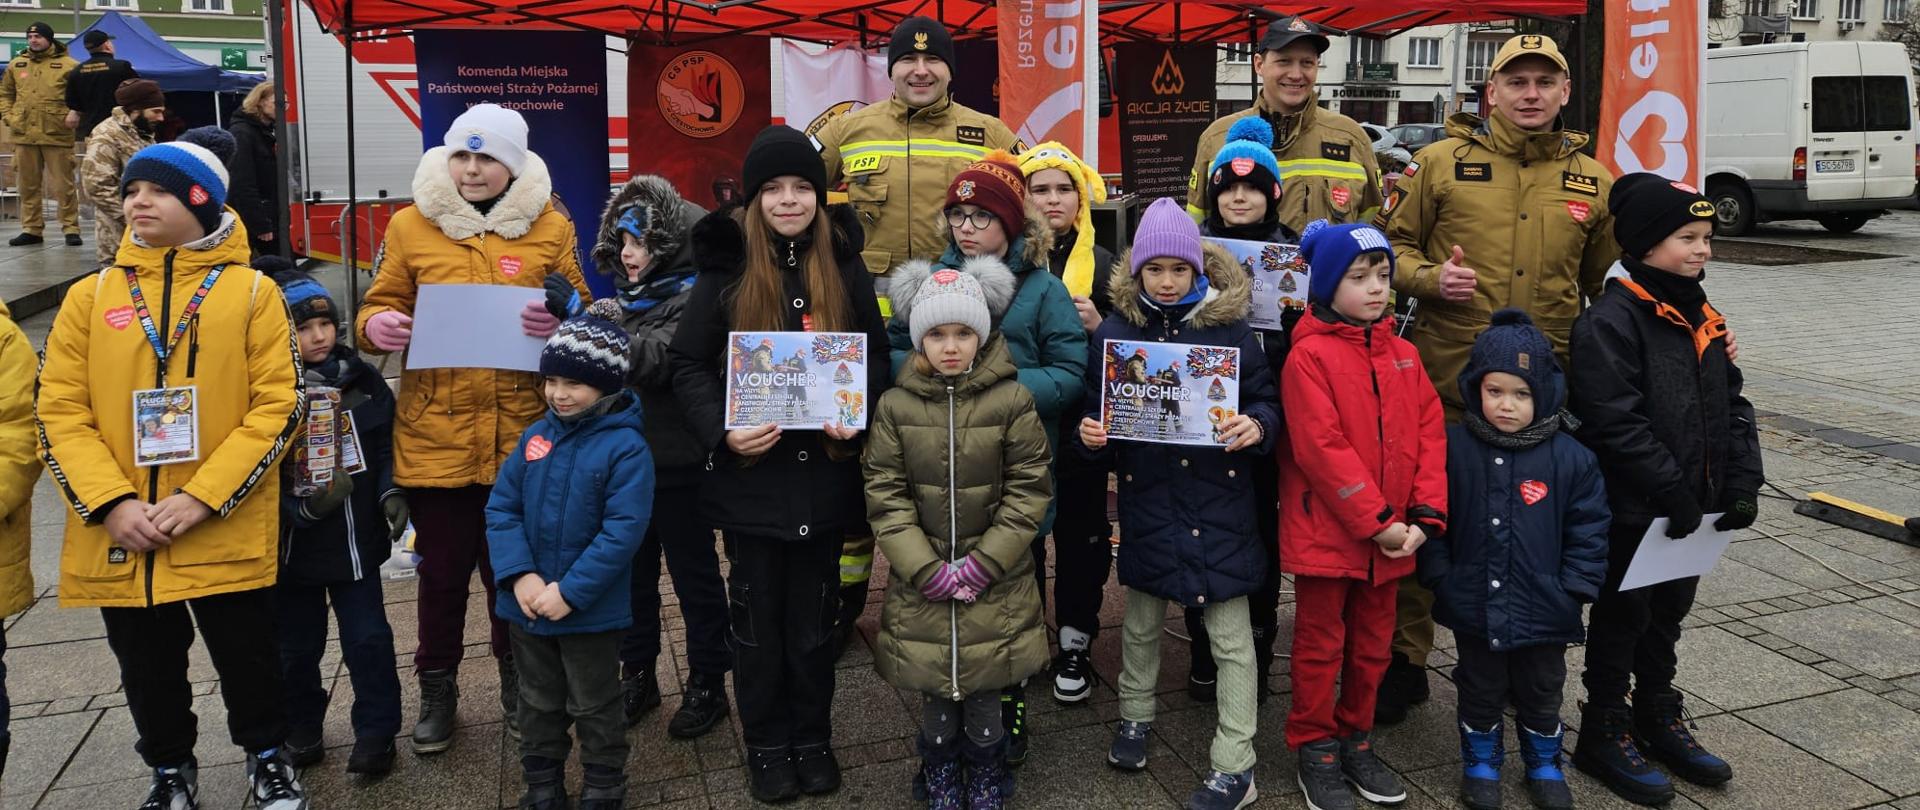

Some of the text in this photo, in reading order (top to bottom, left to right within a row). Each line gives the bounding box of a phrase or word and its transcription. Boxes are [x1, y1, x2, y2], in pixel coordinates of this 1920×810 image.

[682, 56, 705, 68] PSP
[457, 66, 568, 78] Komenda Miejska
[428, 83, 599, 95] Państwowej Straży Pożarnej
[1332, 89, 1401, 98] BOULANGERIE
[1128, 99, 1210, 115] AKCJA ŻYCIE
[854, 157, 876, 168] PSP
[1278, 252, 1298, 264] 32
[831, 340, 851, 355] 32
[1204, 354, 1226, 369] 32
[736, 373, 817, 387] VOUCHER
[1110, 382, 1192, 401] VOUCHER
